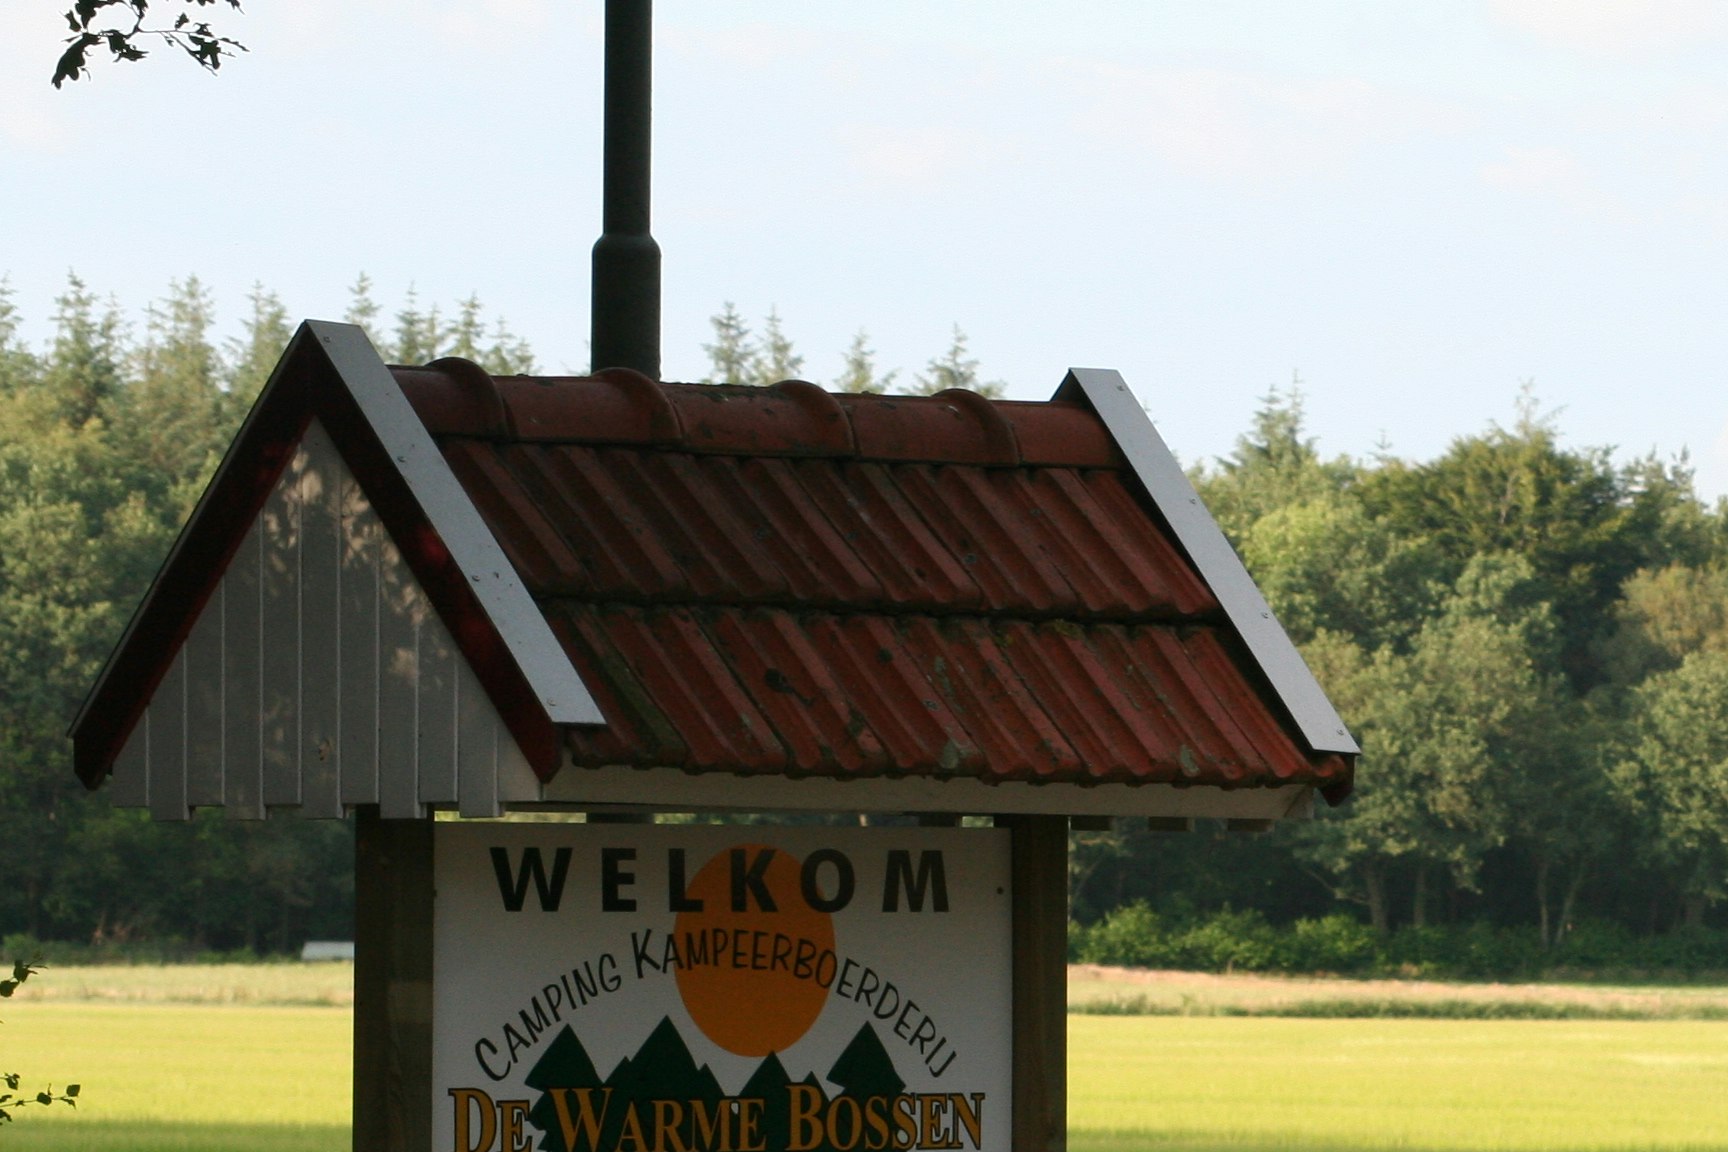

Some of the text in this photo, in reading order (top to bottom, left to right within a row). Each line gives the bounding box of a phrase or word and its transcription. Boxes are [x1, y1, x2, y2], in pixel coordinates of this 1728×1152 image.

[490, 847, 950, 913] WELKOM
[474, 928, 957, 1083] CAMPING KAMPEERBOERDERIJ
